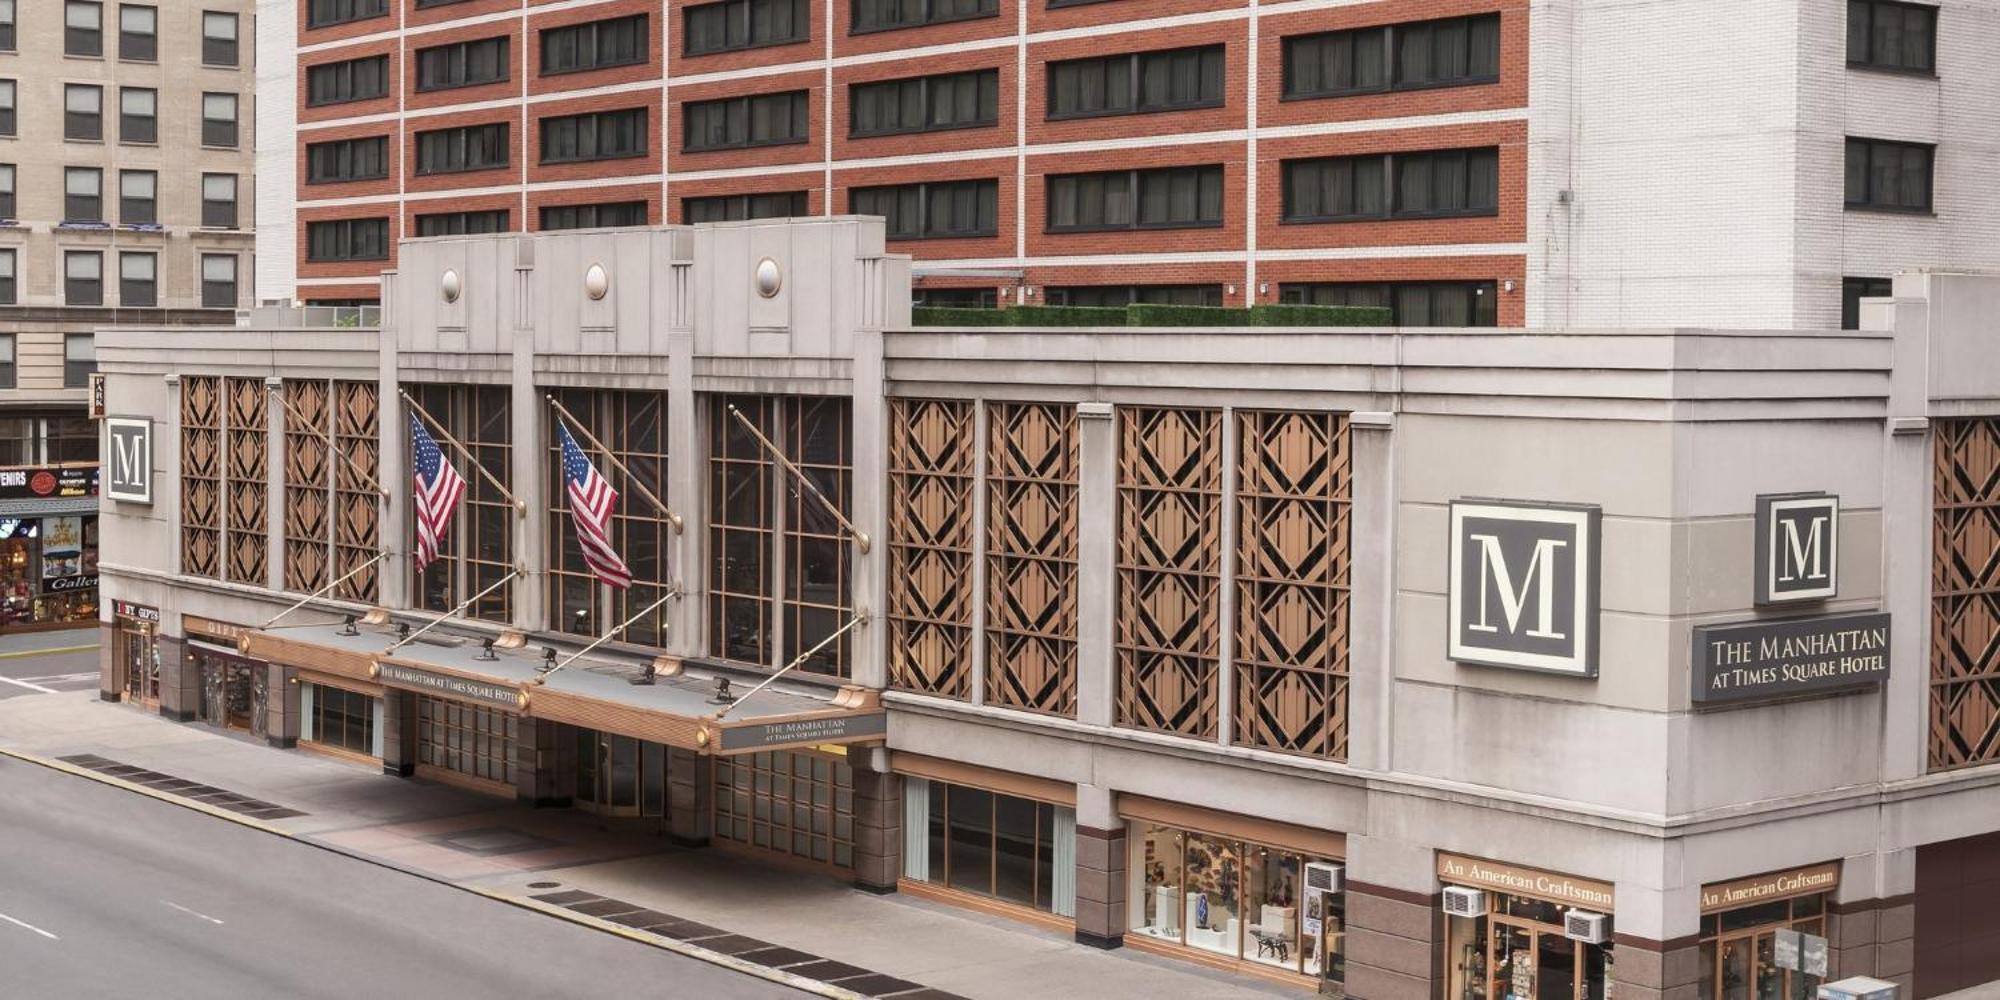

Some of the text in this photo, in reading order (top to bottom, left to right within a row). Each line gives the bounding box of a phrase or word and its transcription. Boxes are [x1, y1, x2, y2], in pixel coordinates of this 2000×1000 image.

[96, 377, 104, 407] PARK
[112, 434, 144, 486] M
[1778, 516, 1828, 582] M
[1468, 533, 1567, 640] M
[1711, 628, 1887, 666] THE MANHATTAN
[380, 664, 393, 678] THE
[395, 668, 436, 687] MANHATTAN
[445, 678, 466, 693] TIMES
[467, 683, 493, 699] SQUARE
[1732, 667, 1777, 687] TIMES
[1782, 660, 1836, 682] SQUARE
[1840, 655, 1886, 674] HOTEL
[765, 719, 845, 735] THE MANHATTAN
[1444, 860, 1612, 904] An American Craftsman
[1702, 871, 1833, 906] An American Craftsman
